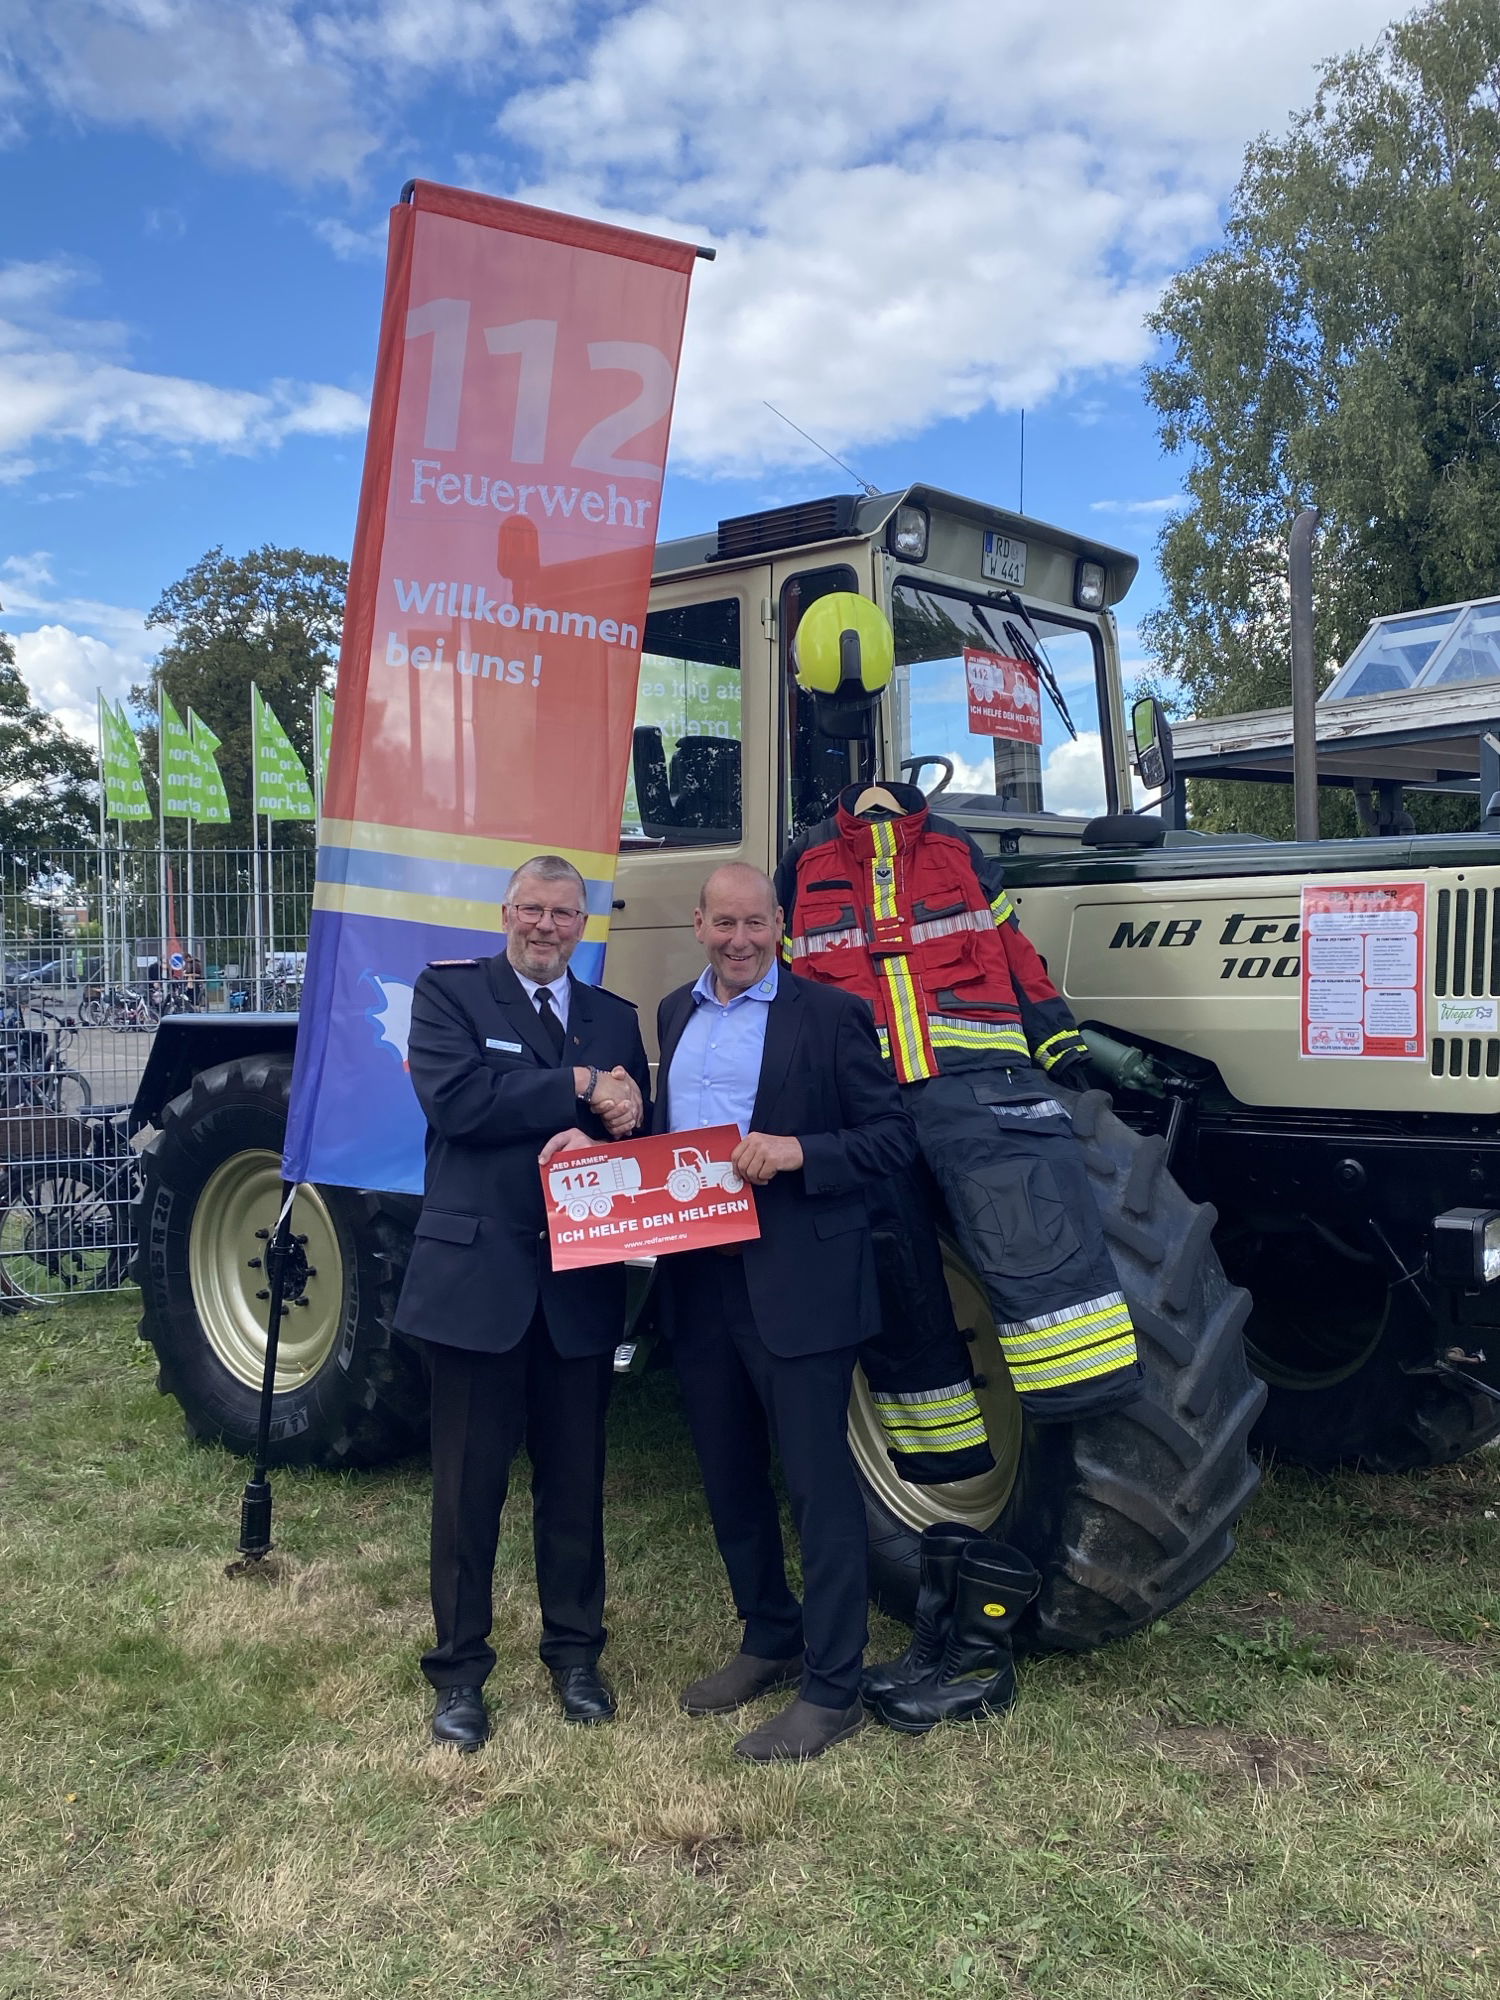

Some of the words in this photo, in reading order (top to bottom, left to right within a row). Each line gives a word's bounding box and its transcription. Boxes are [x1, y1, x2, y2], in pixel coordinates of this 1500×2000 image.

[405, 297, 676, 482] 112
[410, 458, 653, 529] Feuerwehr
[996, 536, 1010, 558] RD
[990, 557, 998, 577] W
[1001, 560, 1020, 583] 441
[393, 578, 639, 650] Willkommen
[386, 633, 445, 668] bei
[457, 650, 542, 688] uns!
[1109, 919, 1202, 949] MB
[561, 1171, 600, 1191] 112
[557, 1230, 585, 1244] ICH
[589, 1218, 639, 1238] HELFE
[643, 1212, 675, 1230] DEN
[678, 1199, 749, 1222] HELFERN
[624, 1232, 688, 1249] www.redfarmer.eu
